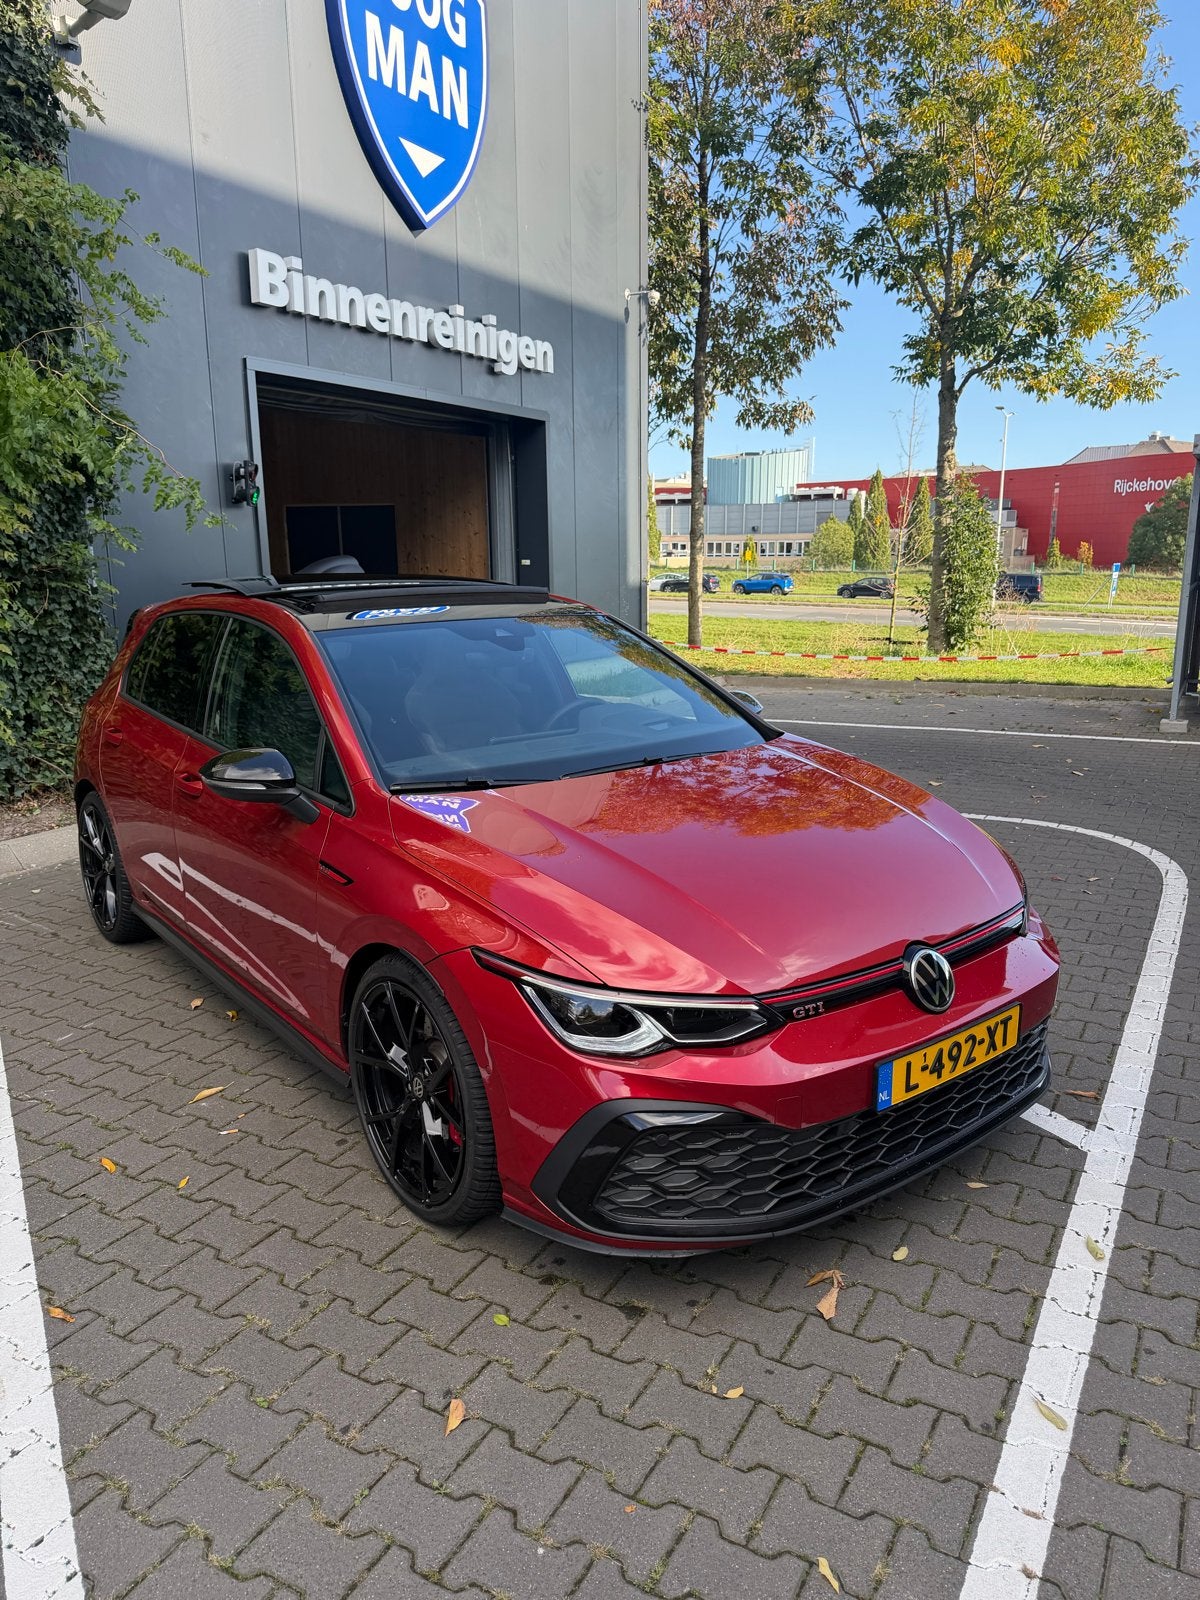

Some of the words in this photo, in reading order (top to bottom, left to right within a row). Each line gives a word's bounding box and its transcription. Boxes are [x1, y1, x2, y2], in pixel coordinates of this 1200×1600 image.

[365, 9, 469, 130] MAN
[248, 247, 555, 376] Binnenreinigen
[792, 1001, 825, 1019] GTI
[878, 1090, 891, 1103] NL
